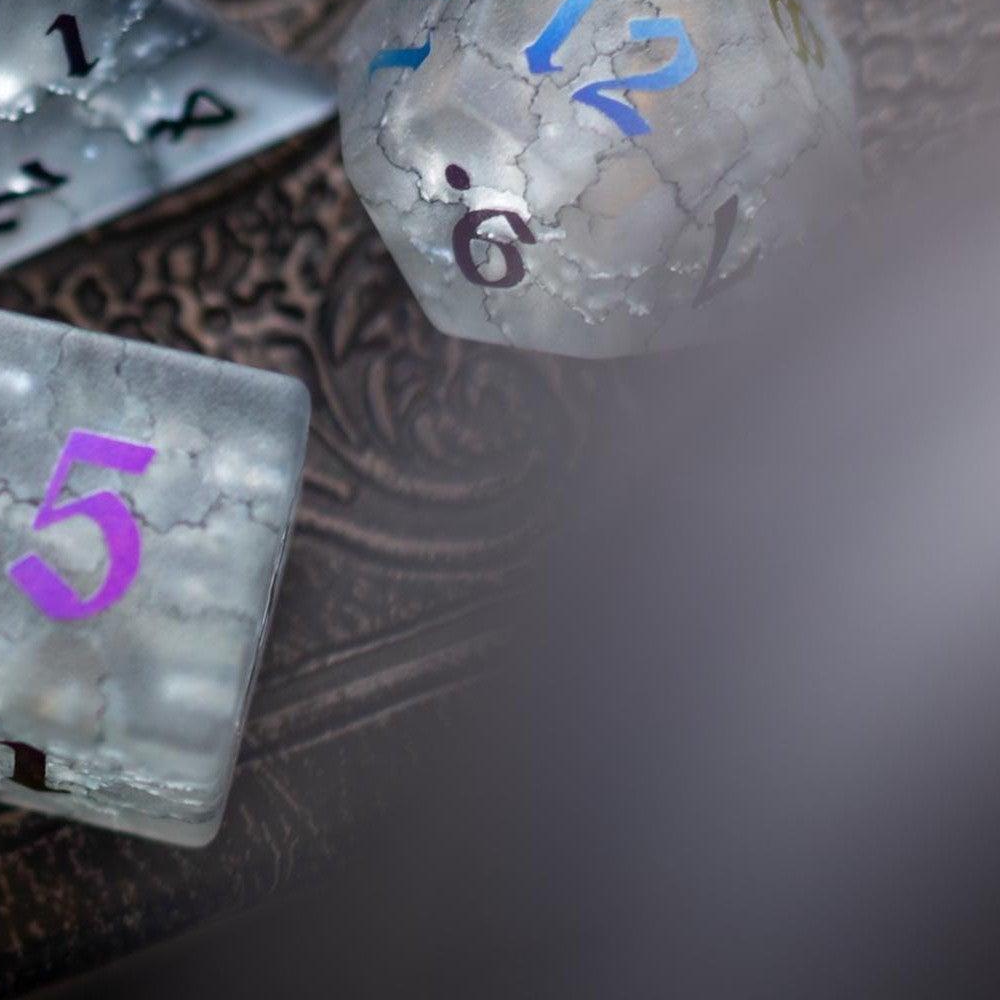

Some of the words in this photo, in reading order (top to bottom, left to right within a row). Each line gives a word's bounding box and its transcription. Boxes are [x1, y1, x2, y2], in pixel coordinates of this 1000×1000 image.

[45, 13, 99, 78] 1
[148, 88, 236, 143] 4
[7, 429, 157, 621] 5
